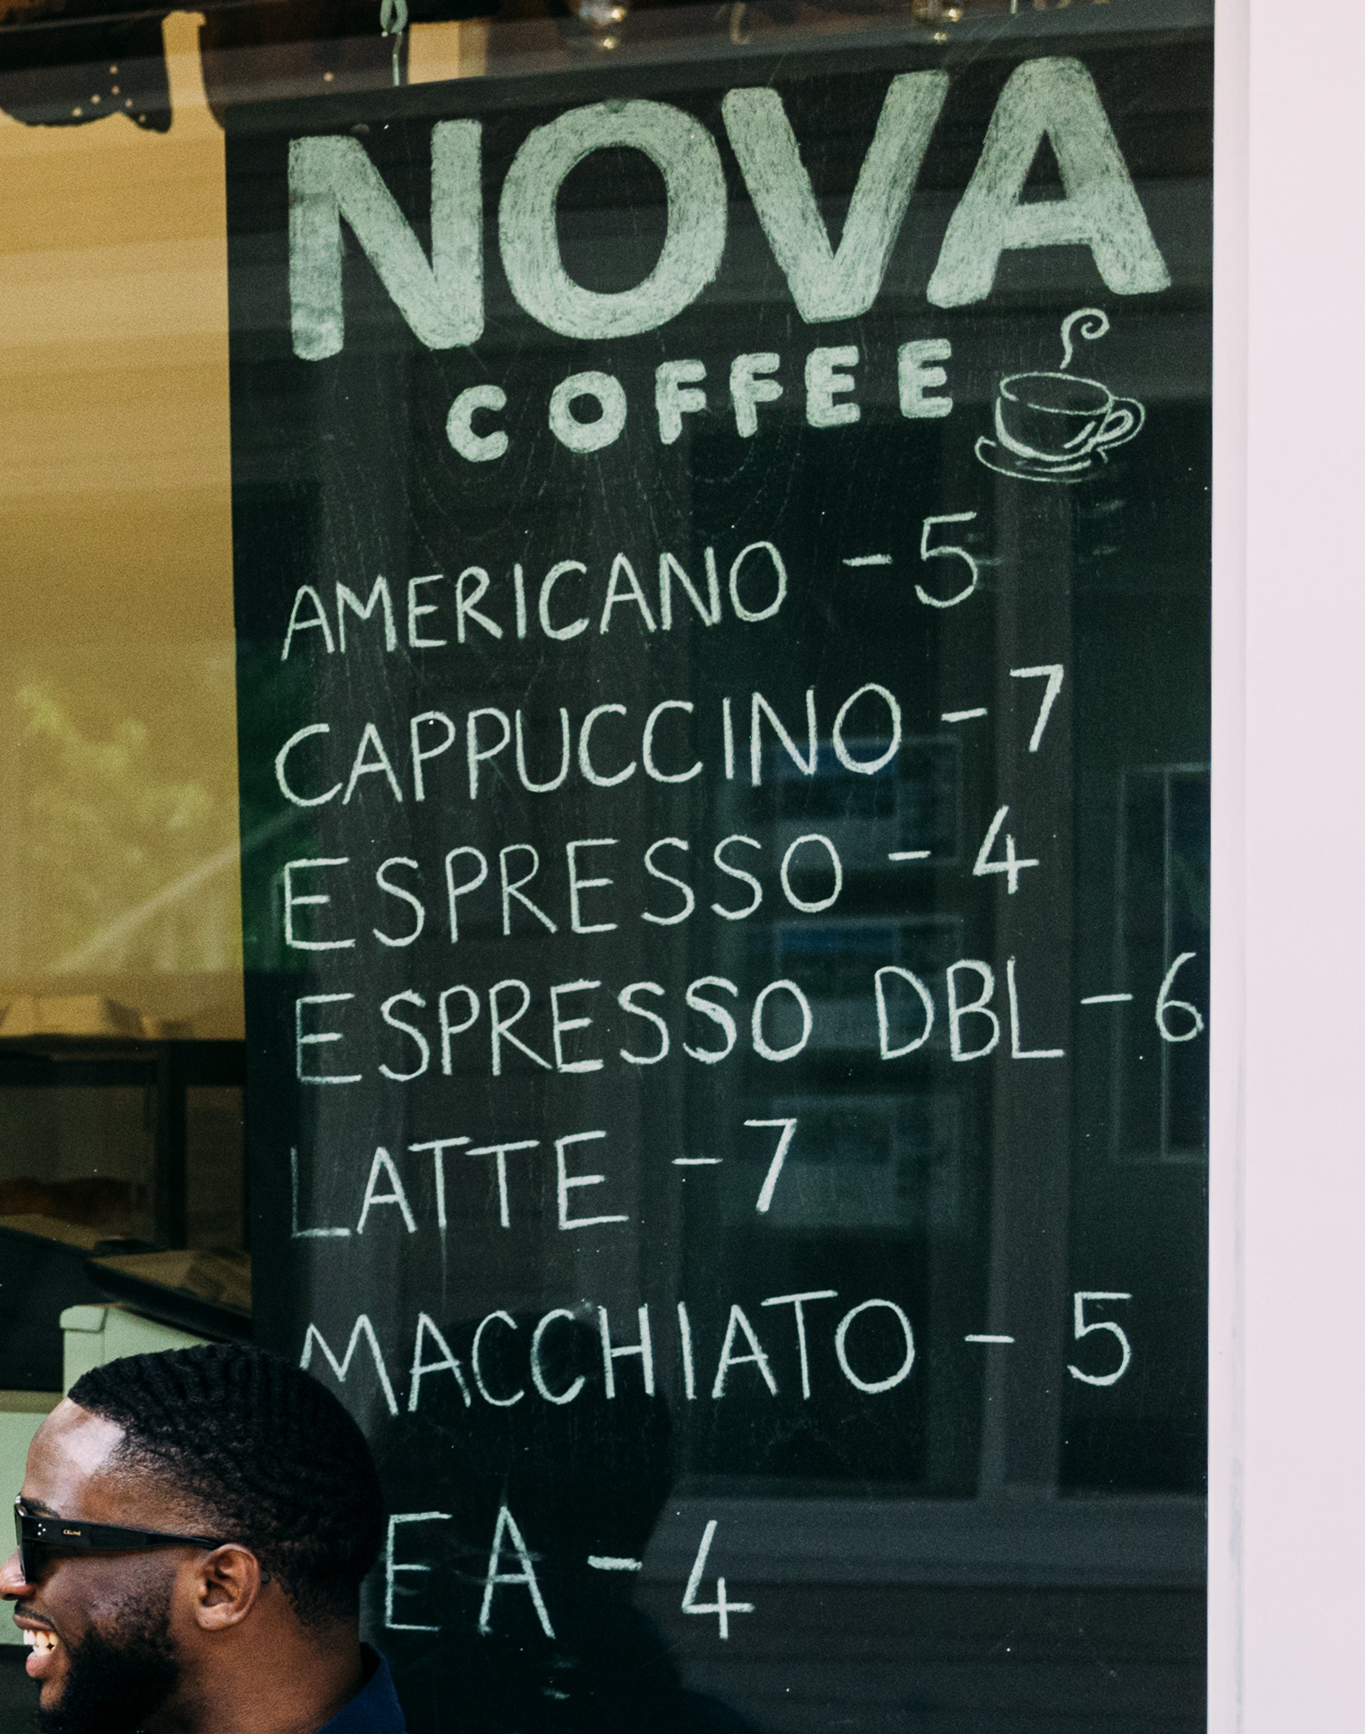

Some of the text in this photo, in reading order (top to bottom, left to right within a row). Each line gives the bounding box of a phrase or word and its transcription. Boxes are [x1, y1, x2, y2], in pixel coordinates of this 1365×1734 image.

[289, 56, 1171, 360] NOVA
[446, 338, 953, 461] COFFEE
[281, 540, 788, 661] AMERICANO
[274, 682, 902, 808] CAPPUCCINO
[280, 833, 843, 951] ESPRESSO
[295, 975, 813, 1084] ESPRESSO
[874, 956, 1065, 1062] DBL
[291, 1130, 629, 1237] LATTE
[299, 1289, 916, 1416] MACCHIATO
